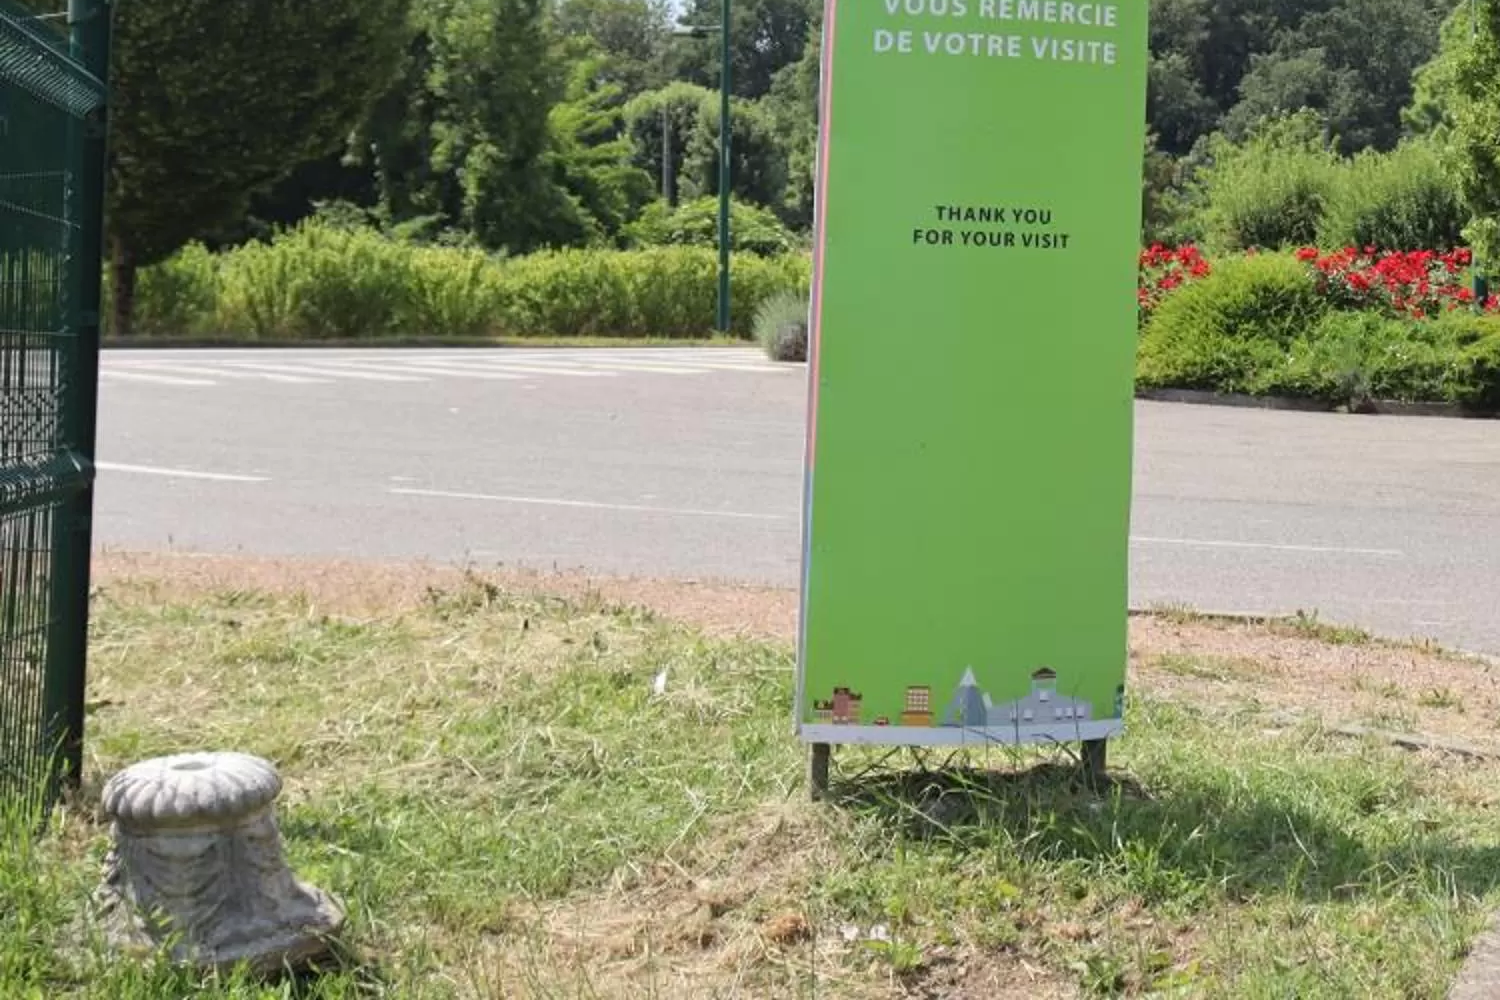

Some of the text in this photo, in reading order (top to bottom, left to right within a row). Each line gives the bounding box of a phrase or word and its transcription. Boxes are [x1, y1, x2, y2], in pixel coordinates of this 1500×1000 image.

[873, 30, 1116, 65] DE VOTRE VISITE
[937, 206, 1052, 225] THANK YOU
[913, 229, 1070, 249] FOR YOUR VISIT
